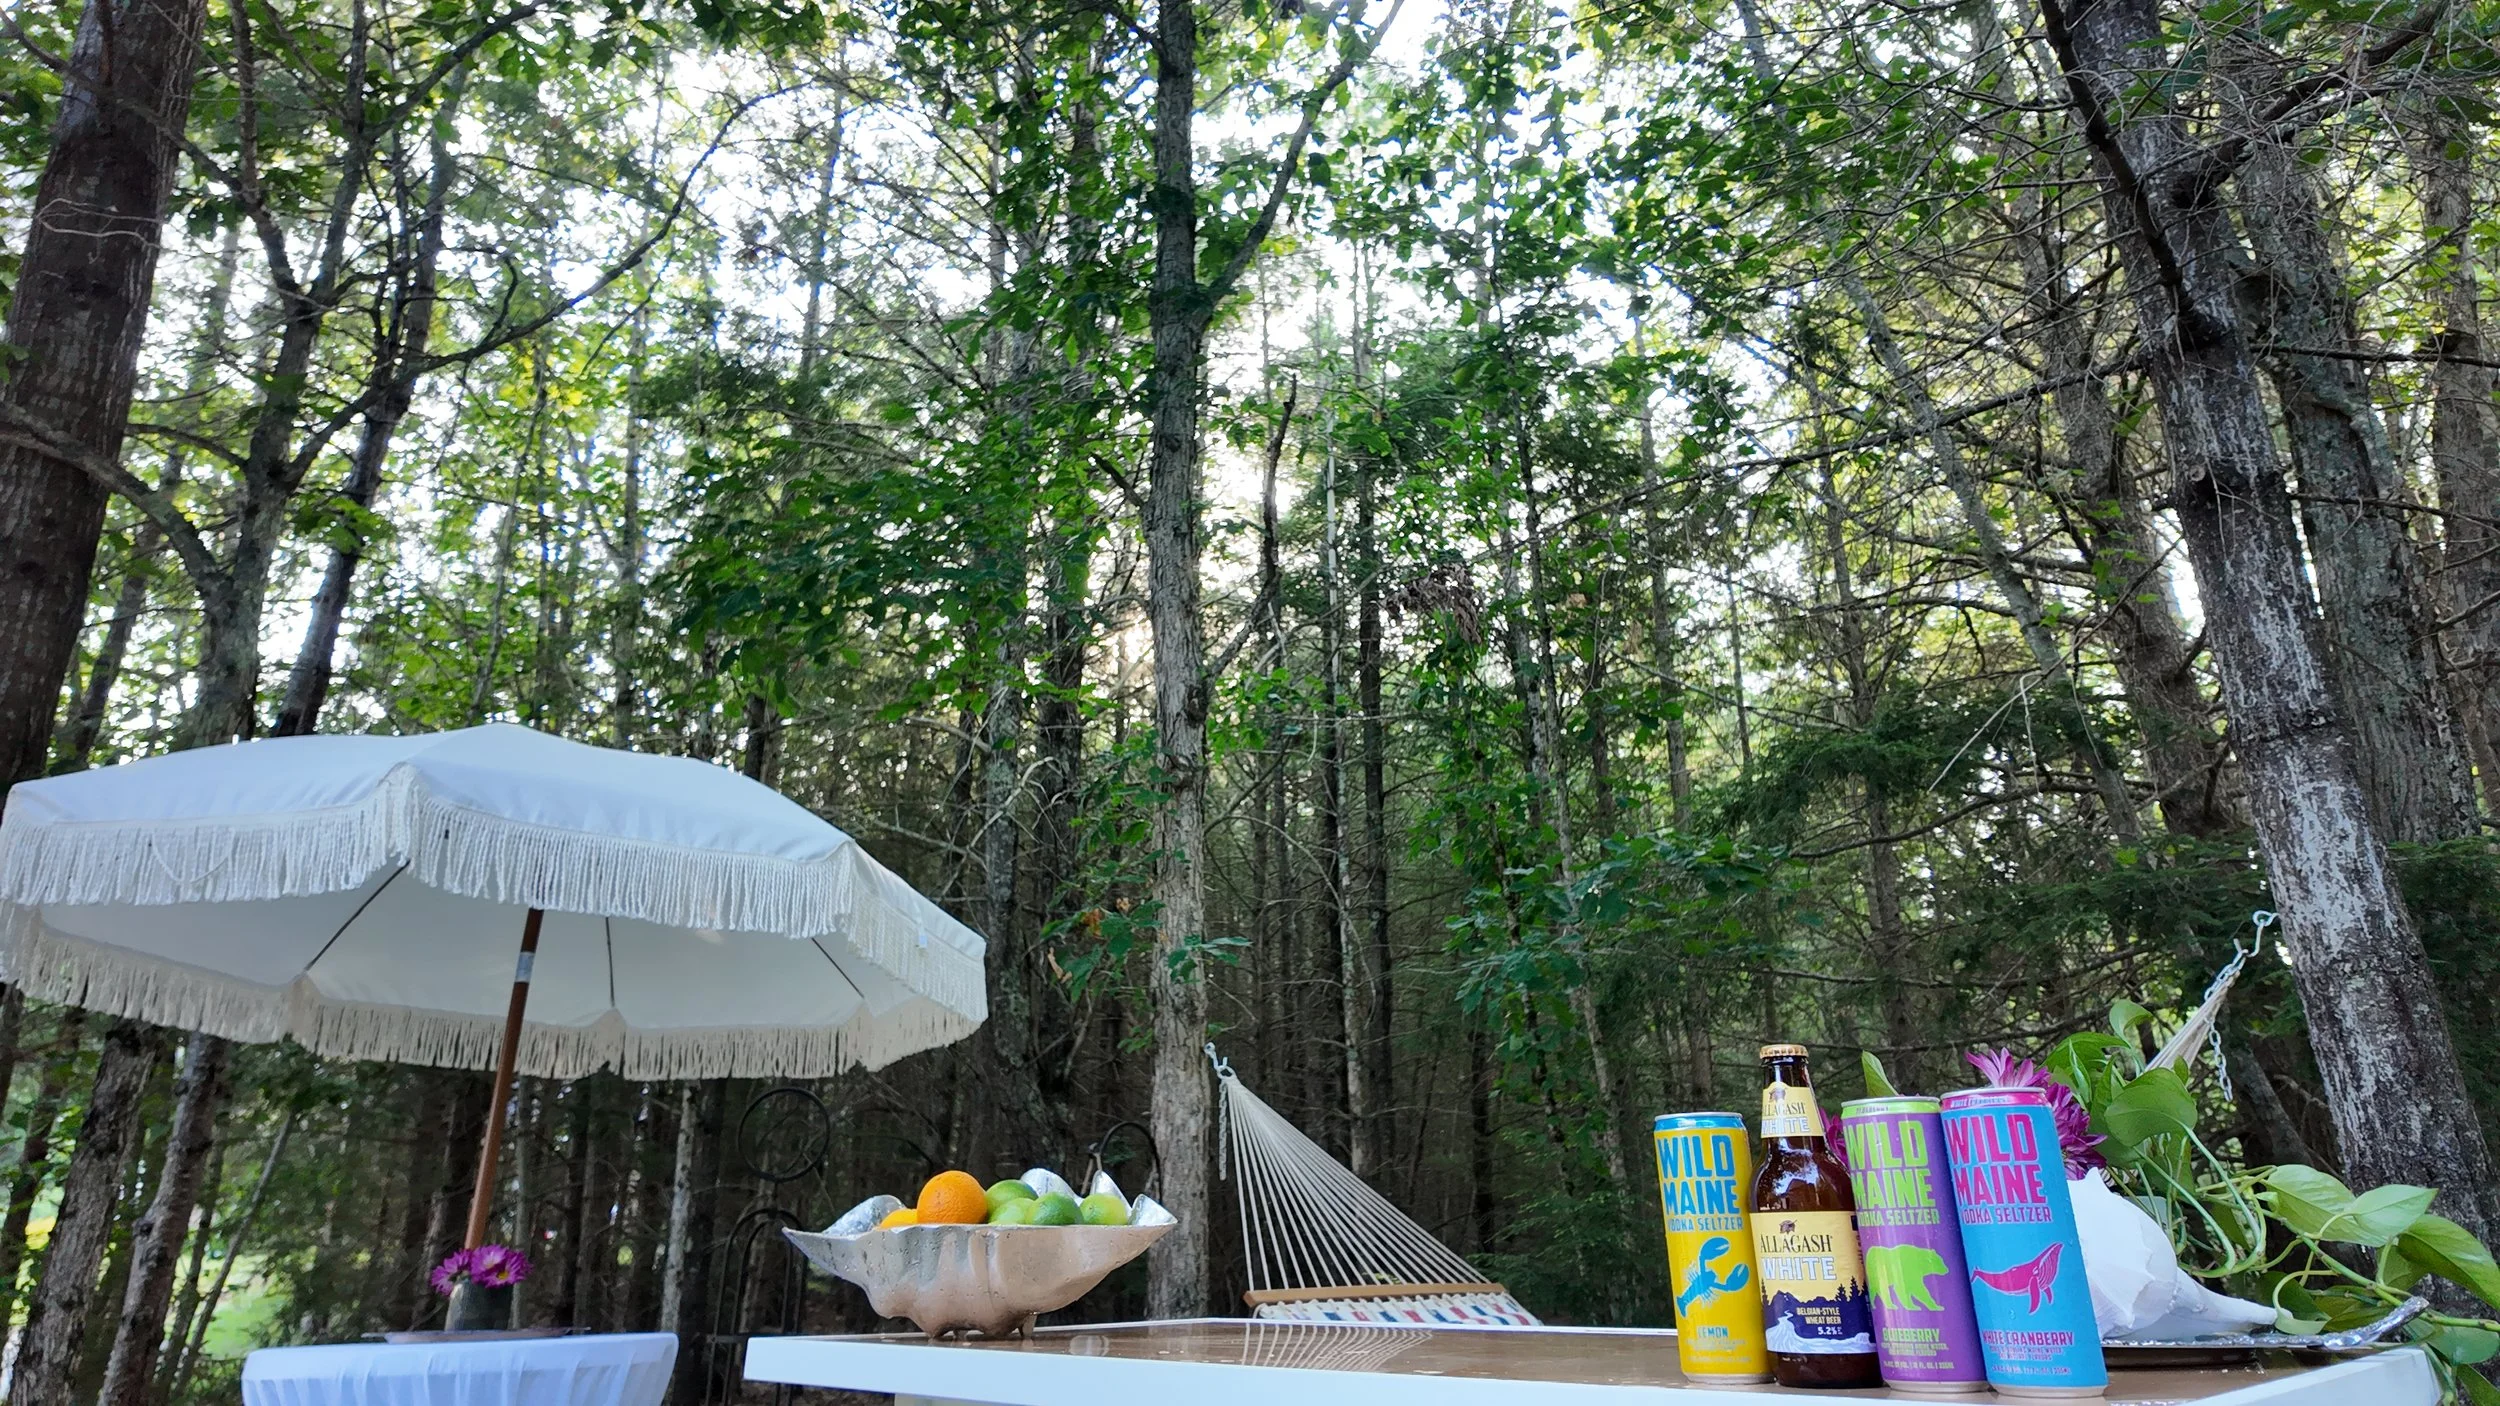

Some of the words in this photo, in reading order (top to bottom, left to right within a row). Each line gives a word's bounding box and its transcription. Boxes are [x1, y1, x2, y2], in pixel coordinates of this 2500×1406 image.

[1843, 1120, 1929, 1171] WILD
[1943, 1113, 2039, 1166] WILD
[1657, 1133, 1736, 1179] WILD
[1851, 1168, 1936, 1210] MAINE
[1952, 1164, 2048, 1207] MAINE
[1663, 1179, 1741, 1215] MAINE
[1696, 1216, 1744, 1231] SELTZER
[1886, 1207, 1941, 1226] SELTZER
[1995, 1206, 2053, 1224] SELTZER
[1760, 1233, 1832, 1254] ALLAGASH
[1761, 1255, 1838, 1281] WHITE
[1796, 1306, 1841, 1316] BELGIAN-STYLE
[1805, 1316, 1826, 1325] WHEAT
[1826, 1316, 1842, 1325] BEER
[1697, 1326, 1729, 1339] LEMON
[1817, 1326, 1838, 1336] 5.2%
[1882, 1327, 1940, 1342] BLUEBERRY
[1983, 1329, 2005, 1345] WHITE
[2005, 1330, 2074, 1346] CRANBERRY
